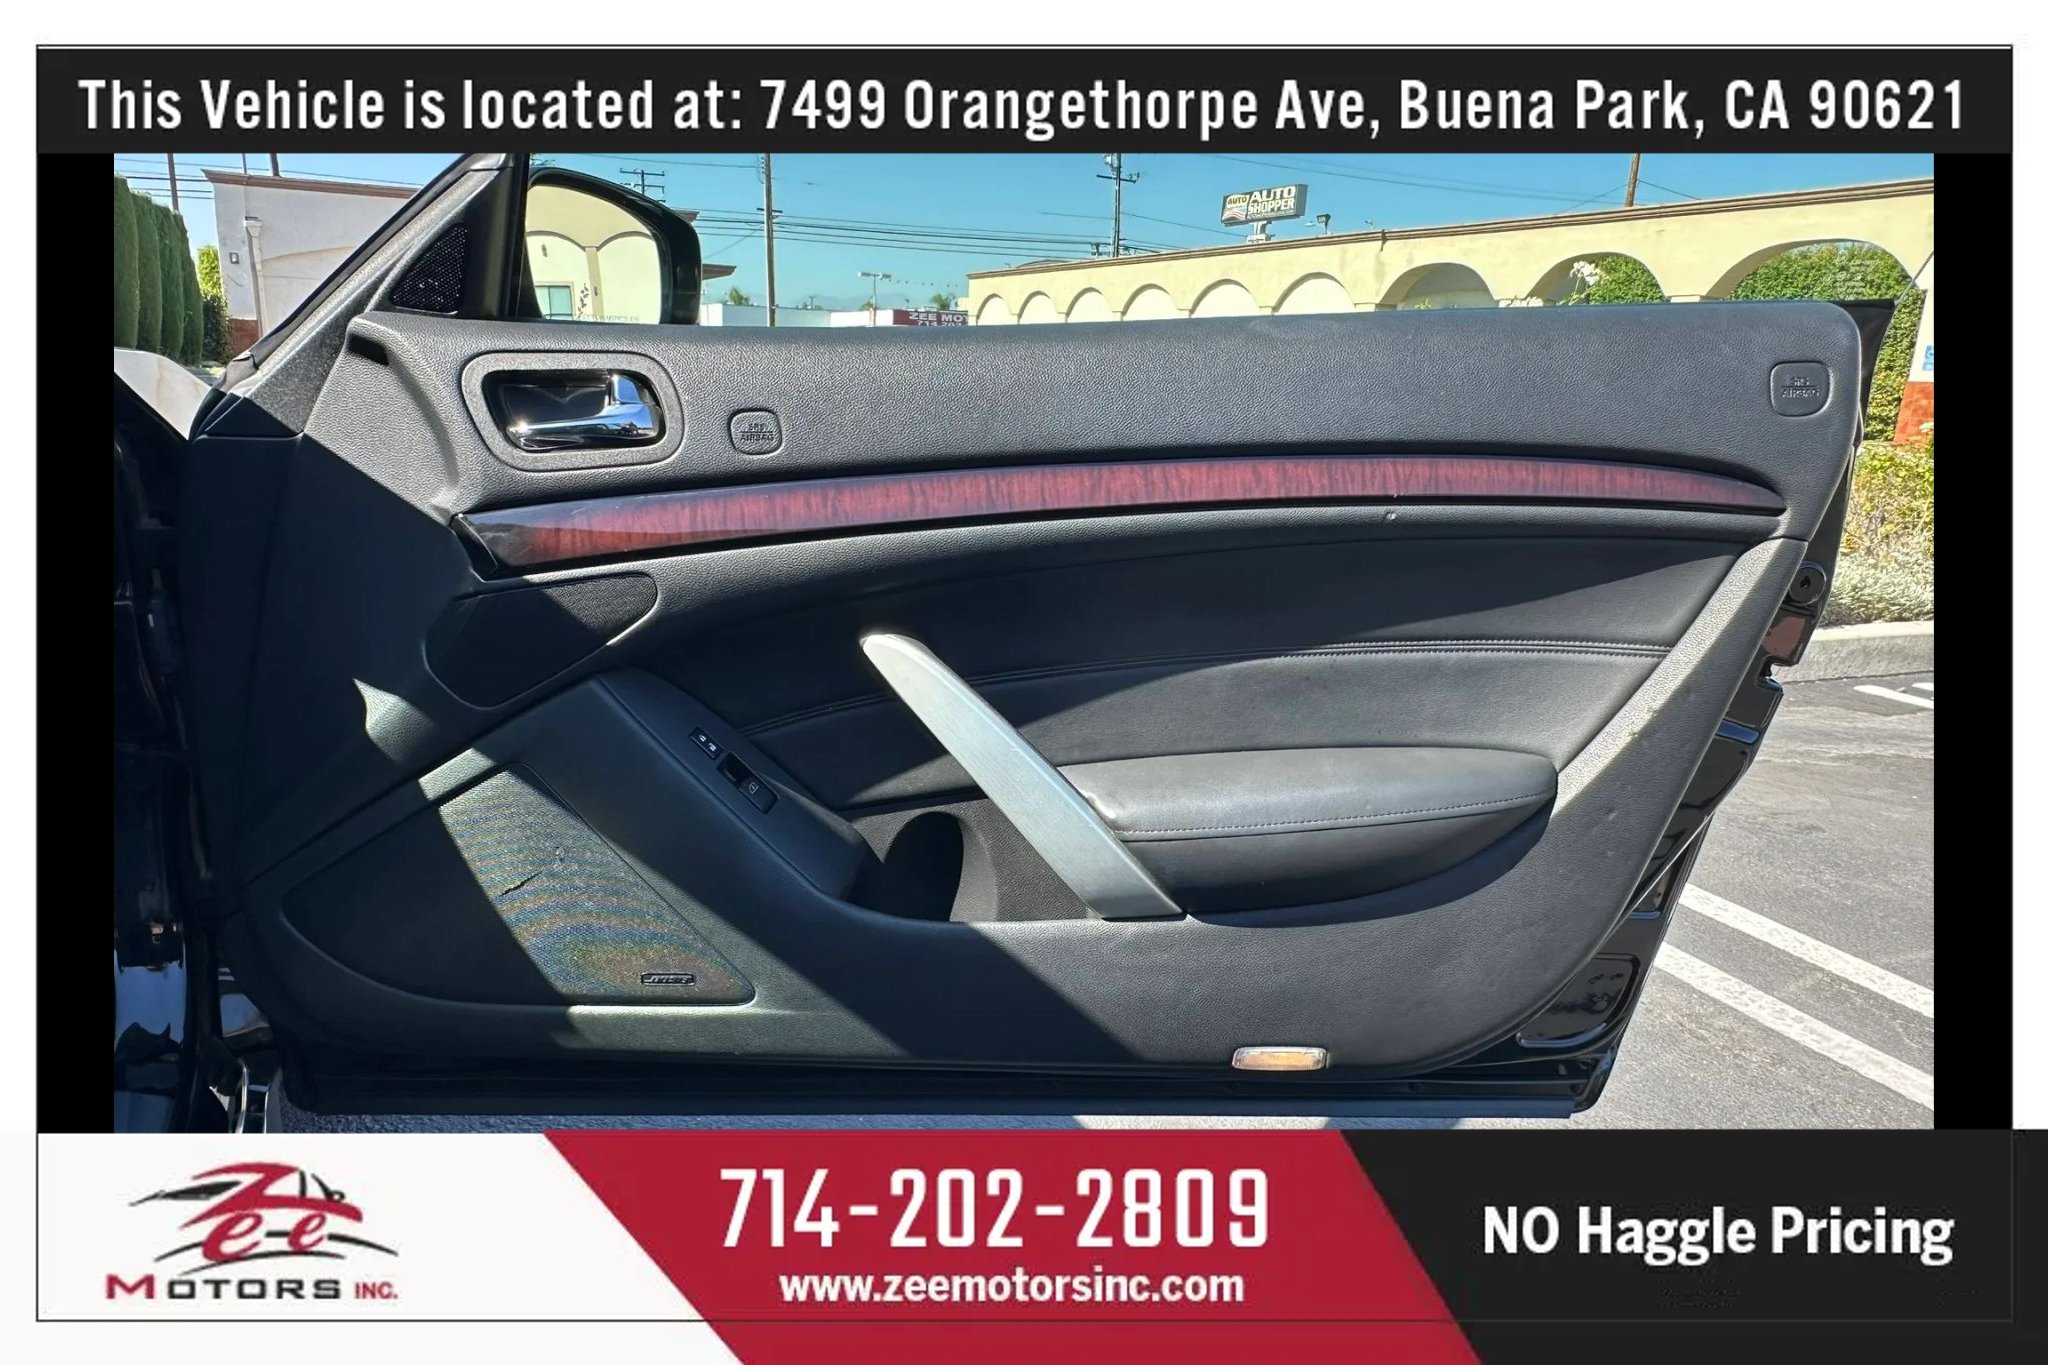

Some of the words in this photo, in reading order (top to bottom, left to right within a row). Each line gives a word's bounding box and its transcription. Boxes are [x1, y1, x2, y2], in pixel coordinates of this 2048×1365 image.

[1227, 196, 1248, 205] AUTO
[1250, 186, 1296, 203] AUTO
[1248, 198, 1295, 214] SHOPPER
[909, 312, 937, 320] ZEE
